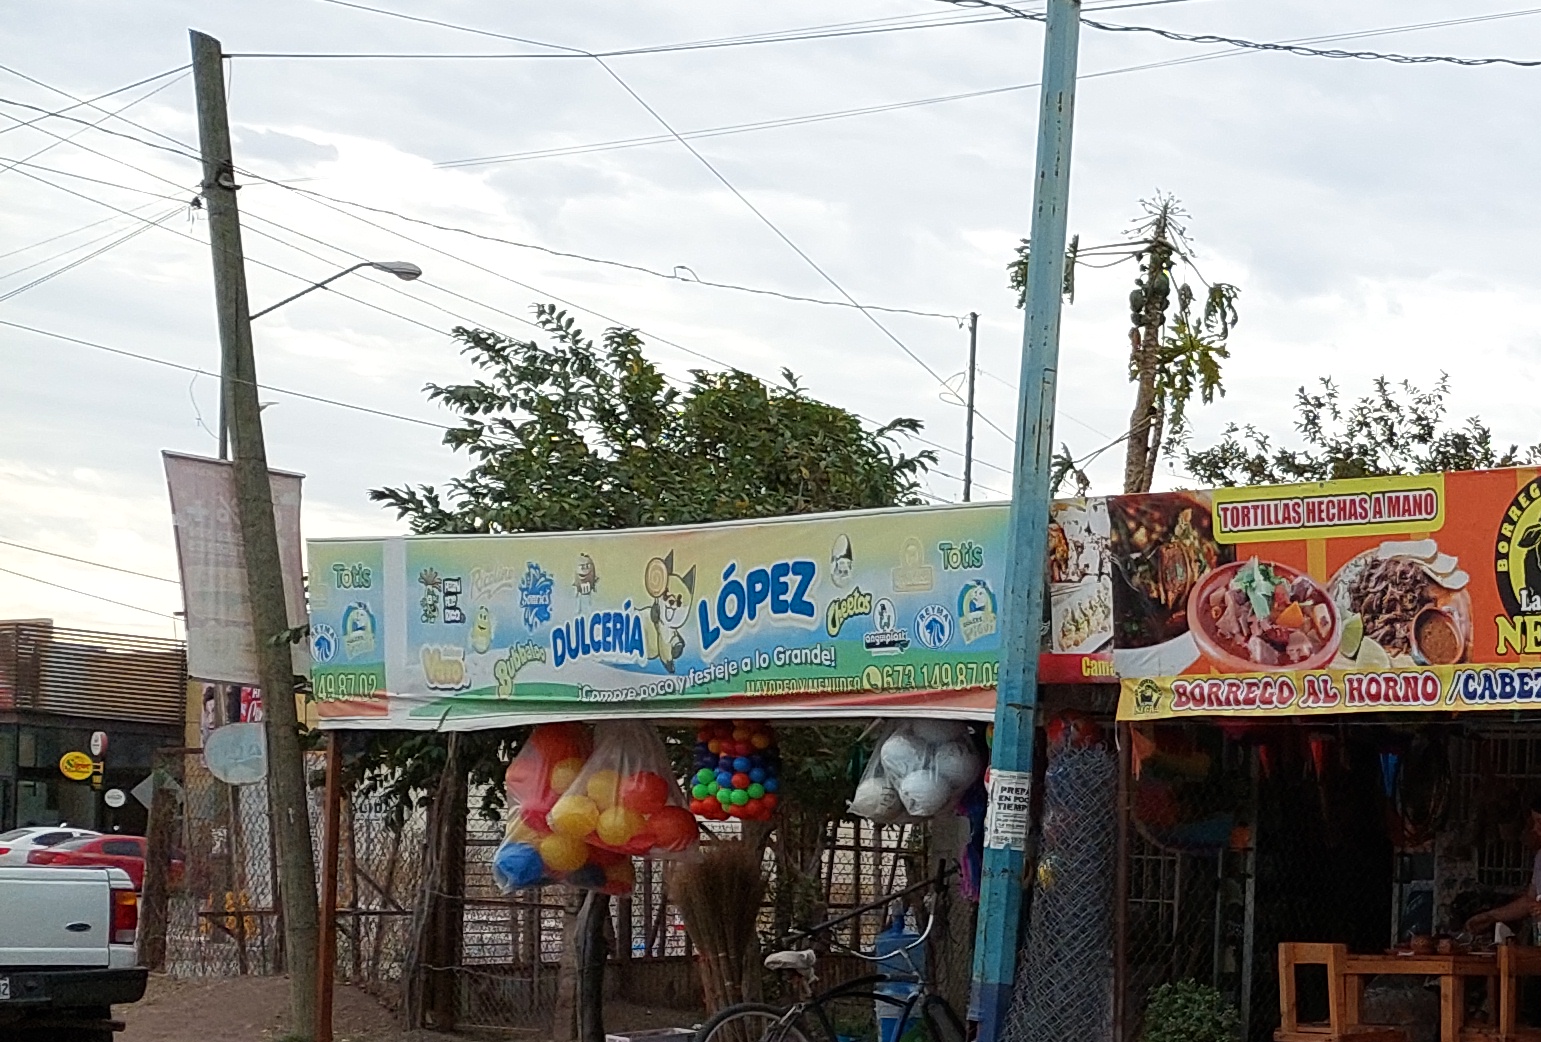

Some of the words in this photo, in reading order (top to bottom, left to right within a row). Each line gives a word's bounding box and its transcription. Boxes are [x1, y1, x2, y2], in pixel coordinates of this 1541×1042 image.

[1220, 501, 1301, 529] TORTILLAS
[1305, 497, 1368, 523] HECHAS
[1372, 495, 1385, 520] A
[1387, 490, 1436, 517] MANO
[333, 563, 372, 589] Totis
[939, 541, 983, 570] Totis
[698, 562, 816, 651] LÓPEZ
[552, 600, 645, 667] DULCERÍA
[640, 679, 674, 701] poco
[688, 658, 738, 687] festeje
[741, 657, 751, 672] a
[755, 649, 770, 669] lo
[773, 643, 836, 667] Grande!
[1171, 671, 1295, 711] BORREGO
[1299, 671, 1338, 706] AL
[1344, 669, 1441, 706] HORNO
